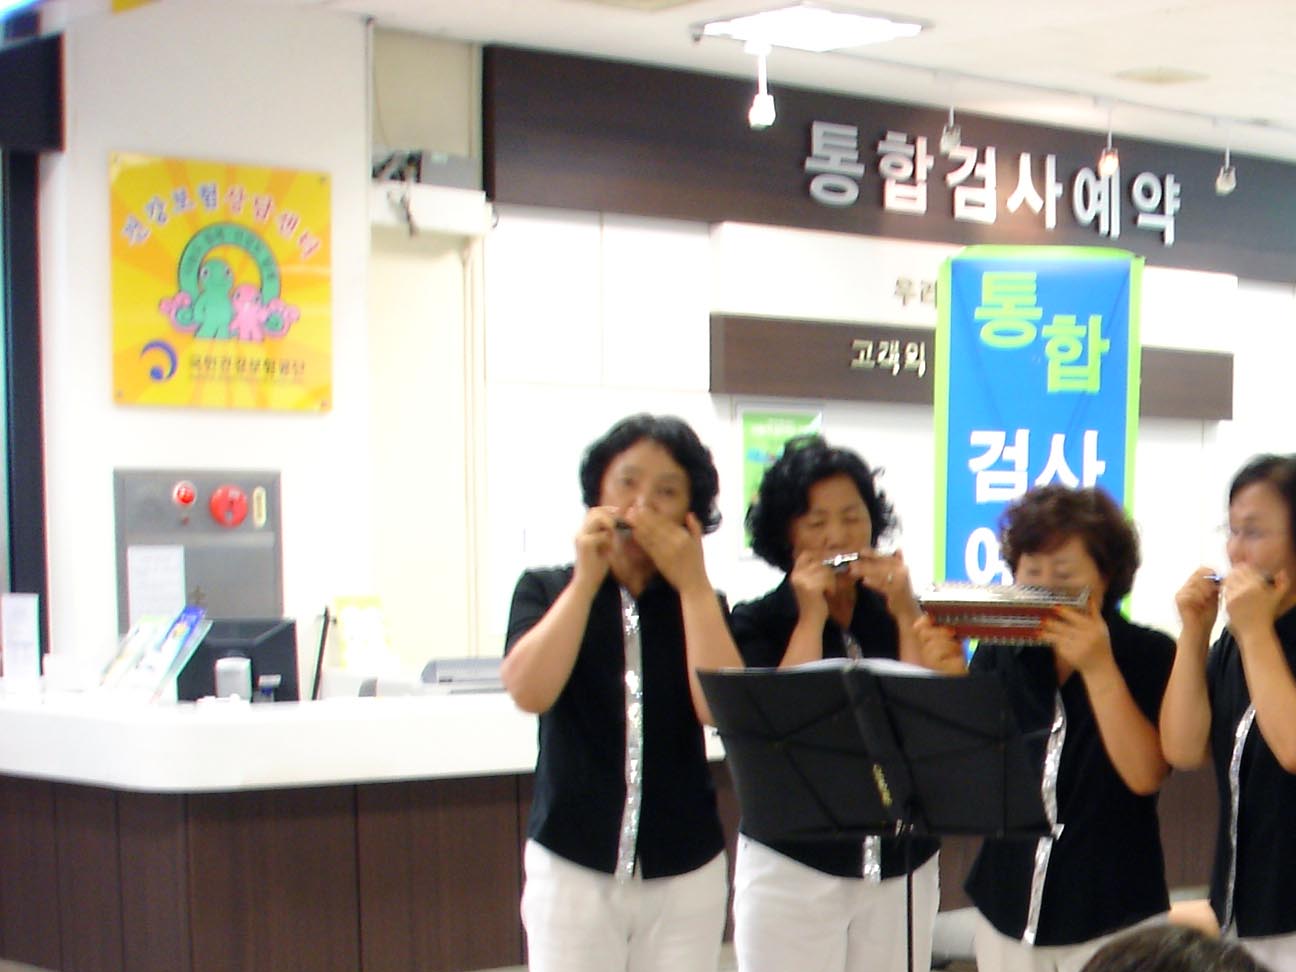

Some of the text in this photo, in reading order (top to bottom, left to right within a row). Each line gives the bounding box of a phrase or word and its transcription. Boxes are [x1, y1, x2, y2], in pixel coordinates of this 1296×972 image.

[804, 120, 1182, 246] 통합검사예약
[850, 338, 926, 378] 고객의
[974, 271, 1110, 394] 통합
[967, 427, 1106, 504] 검사
